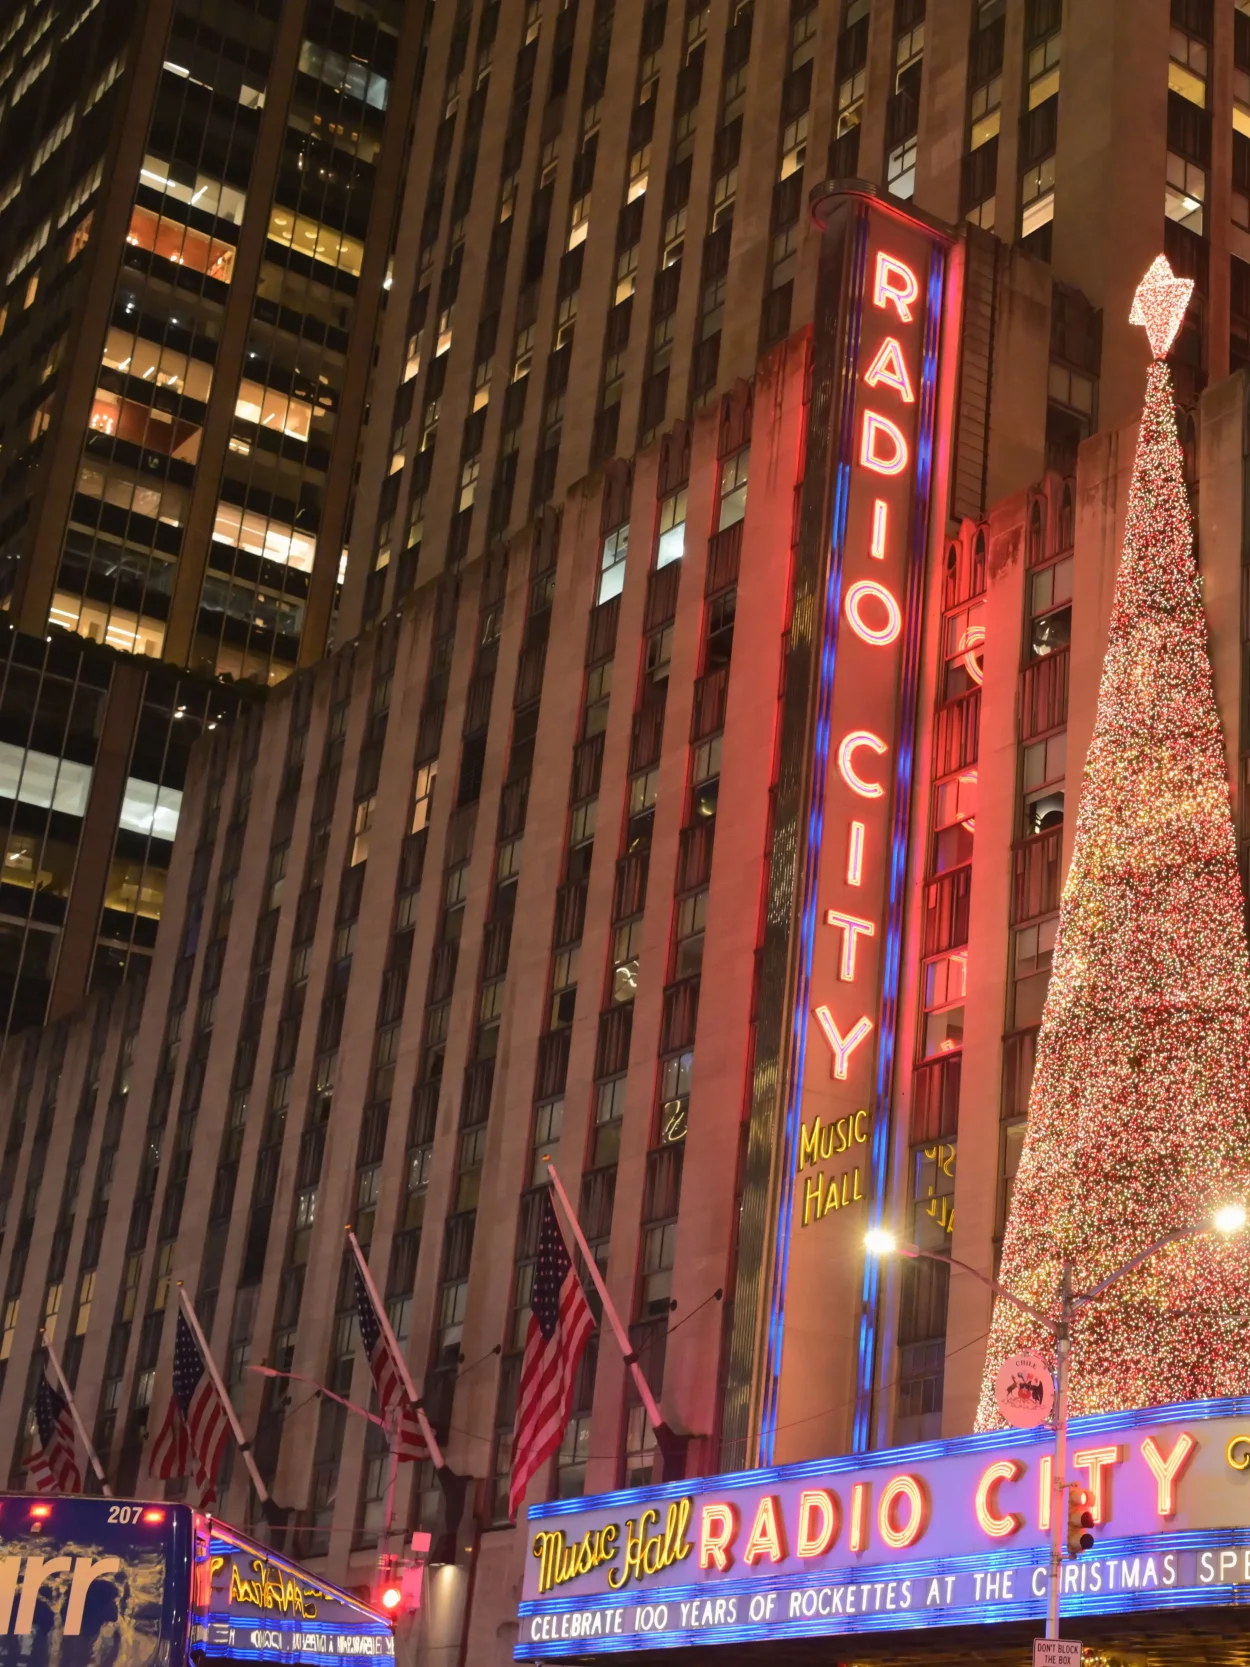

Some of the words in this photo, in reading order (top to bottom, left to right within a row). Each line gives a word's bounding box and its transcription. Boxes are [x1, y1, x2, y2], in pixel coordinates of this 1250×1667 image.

[846, 251, 918, 646] RADIO
[814, 730, 889, 1080] CITY
[1016, 1360, 1038, 1369] CHILE
[107, 1505, 143, 1524] 207
[533, 1527, 617, 1593] Music
[609, 1497, 695, 1588] Hall
[699, 1474, 926, 1571] RADIO
[976, 1432, 1195, 1538] CITY
[530, 1607, 622, 1641] CELEBRATE
[635, 1602, 667, 1630] 100
[681, 1593, 736, 1627] YEARS
[750, 1591, 776, 1621] OF
[789, 1580, 911, 1616] ROCKETTES
[928, 1576, 956, 1602] AT
[974, 1569, 1014, 1599] THE
[1037, 1643, 1056, 1653] DON'T
[1057, 1644, 1079, 1654] BLOCK
[1044, 1655, 1057, 1664] THE
[1058, 1656, 1071, 1665] BOX
